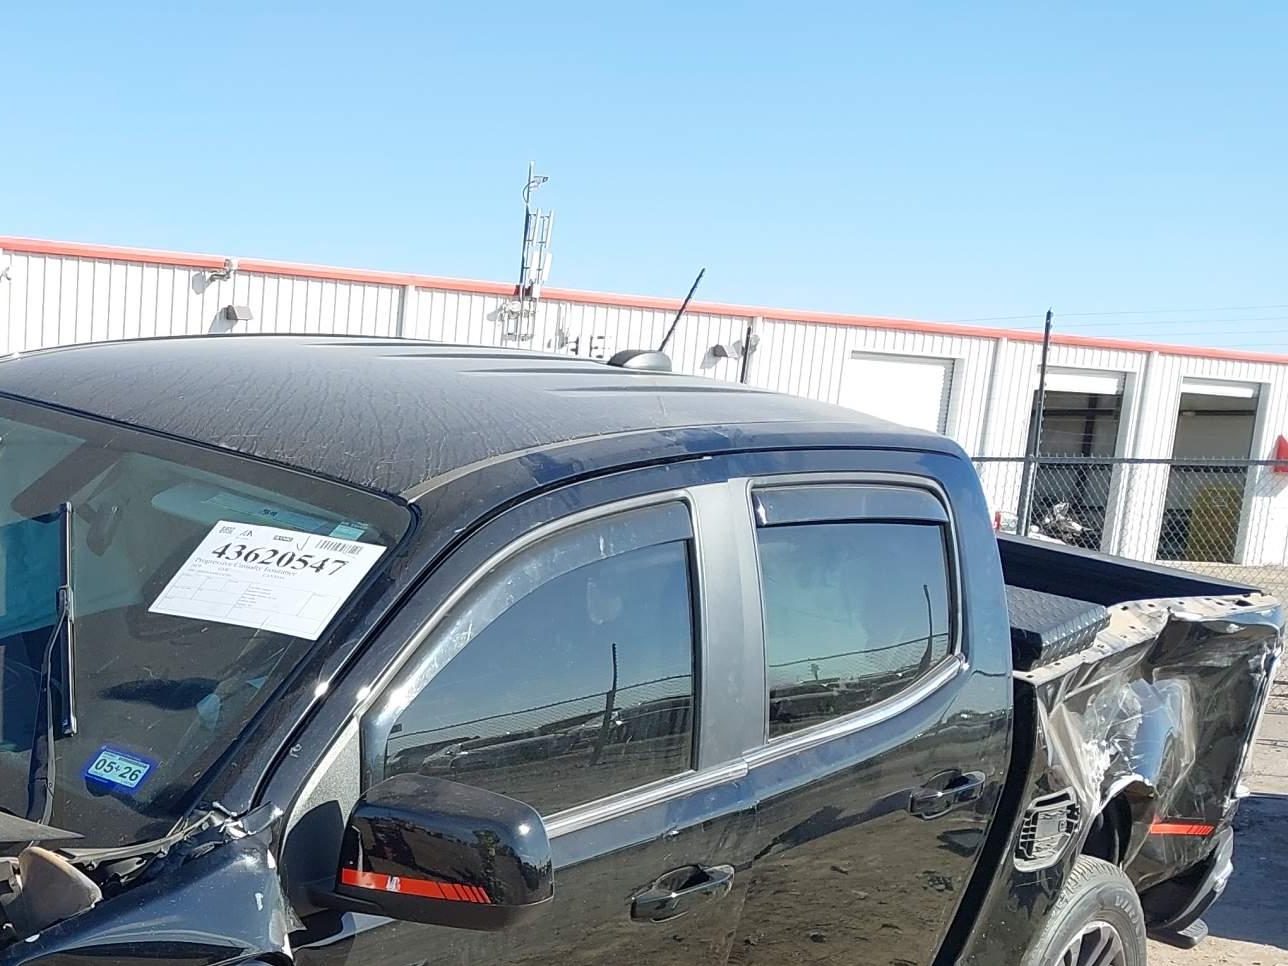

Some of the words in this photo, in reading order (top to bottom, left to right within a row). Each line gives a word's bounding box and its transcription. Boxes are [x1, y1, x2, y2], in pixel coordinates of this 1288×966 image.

[211, 542, 350, 577] 43620547
[94, 758, 117, 774] 05
[118, 766, 143, 782] 26
